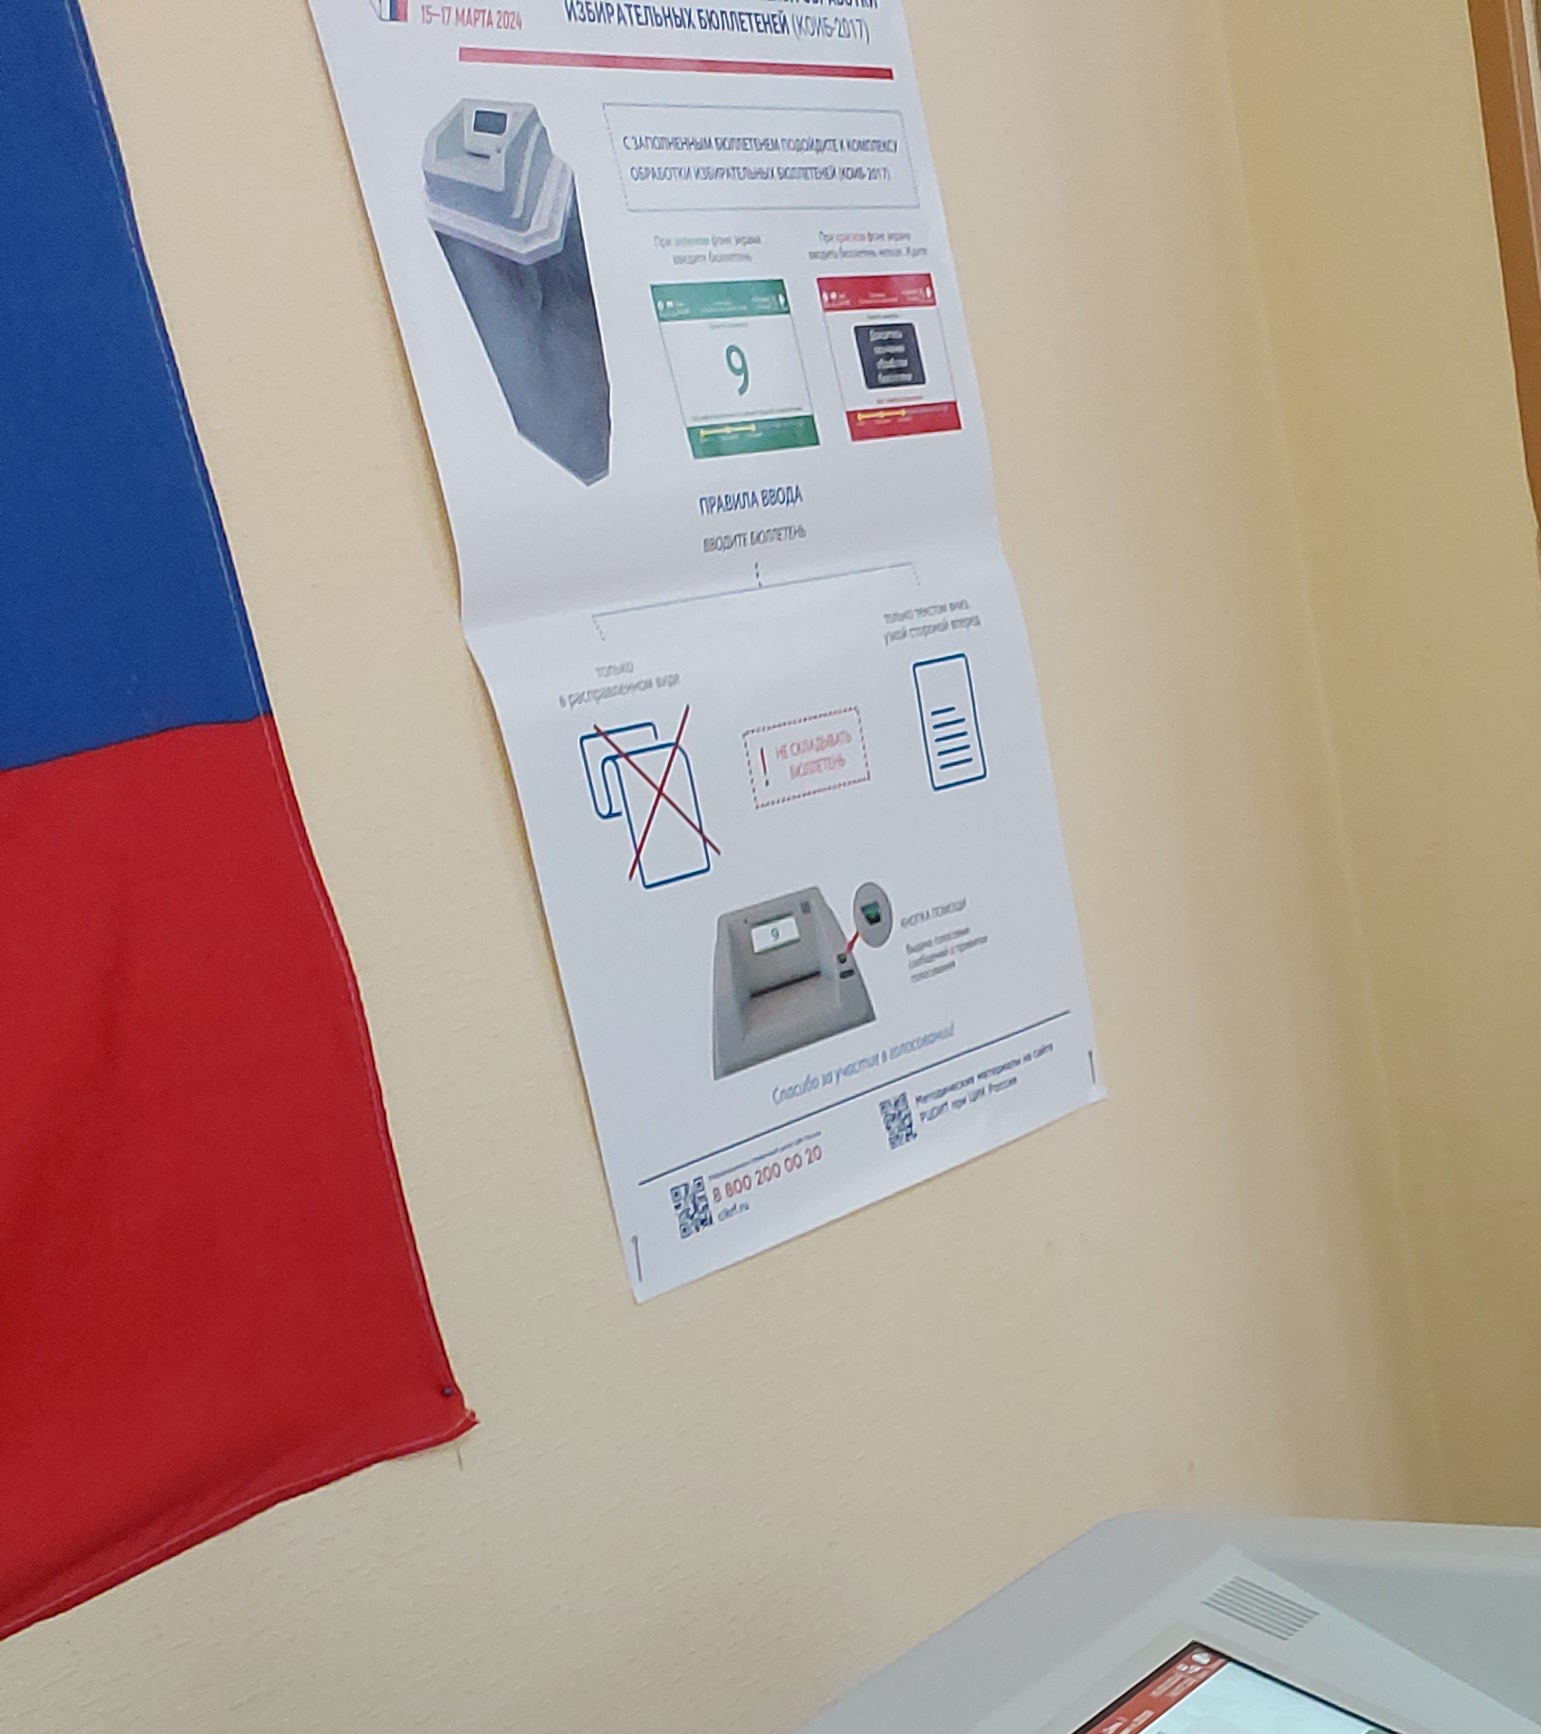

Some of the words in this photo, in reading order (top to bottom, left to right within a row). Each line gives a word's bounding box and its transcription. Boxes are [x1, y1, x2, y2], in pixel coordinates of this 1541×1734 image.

[455, 9, 494, 29] МАРТА
[496, 10, 523, 30] 2024
[563, 0, 696, 29] ИЗБИРАТЕЛЬНЫХ
[699, 9, 791, 36] БЮЛЛЕТЕНЕЙ
[791, 13, 871, 44] (КОИБ-2017)
[725, 344, 751, 397] 9
[699, 491, 759, 515] ПРАВИЛА
[760, 485, 804, 508] ВВОДА
[703, 532, 748, 553] ВВОДИТЕ
[750, 524, 807, 546] БЮЛЛЕТЕНЬ
[713, 1186, 722, 1203] 8
[725, 1174, 752, 1198] 800
[755, 1162, 781, 1186] 200
[784, 1153, 803, 1173] 00
[805, 1145, 822, 1166] 20
